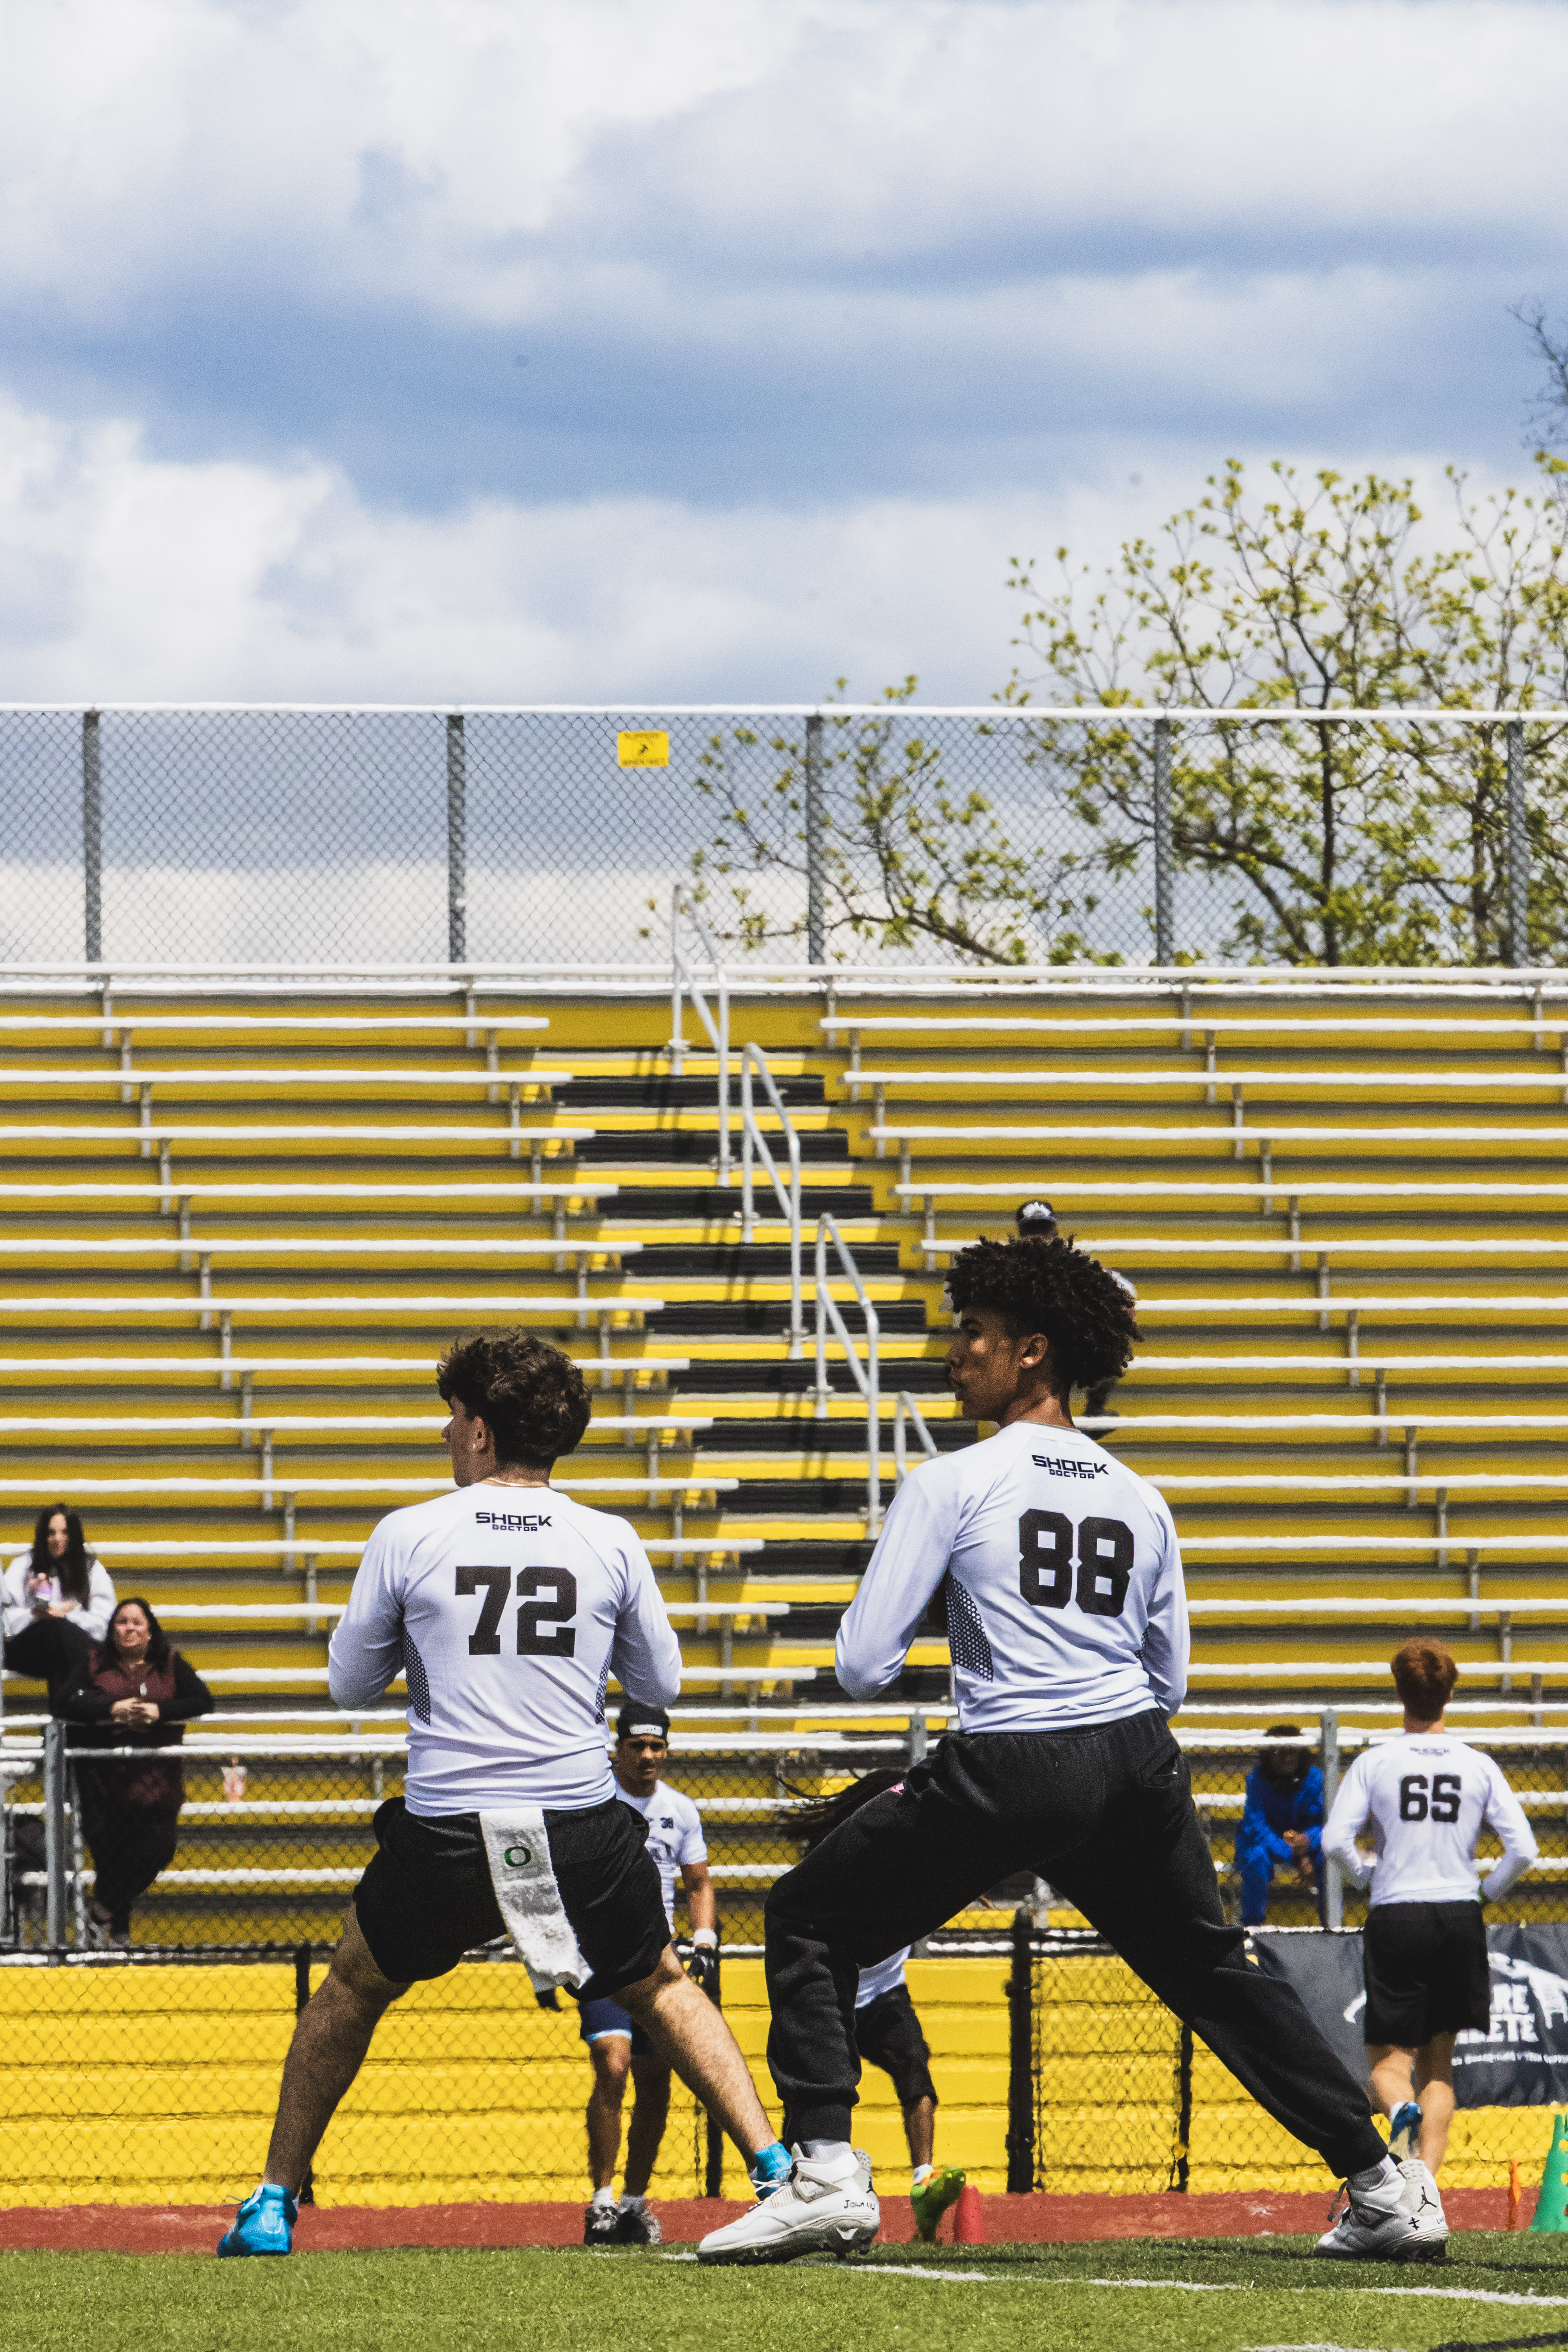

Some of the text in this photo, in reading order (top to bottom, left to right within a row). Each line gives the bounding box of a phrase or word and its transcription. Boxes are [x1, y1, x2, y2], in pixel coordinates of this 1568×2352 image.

[1032, 1455, 1109, 1475] SHOCK
[1049, 1469, 1094, 1479] DOCTOR
[476, 1512, 553, 1527] SHOCK
[1019, 1508, 1134, 1618] 88
[455, 1566, 577, 1658] 72
[1400, 1774, 1461, 1822] 65
[504, 1846, 531, 1867] O
[1489, 1983, 1530, 2014] RE
